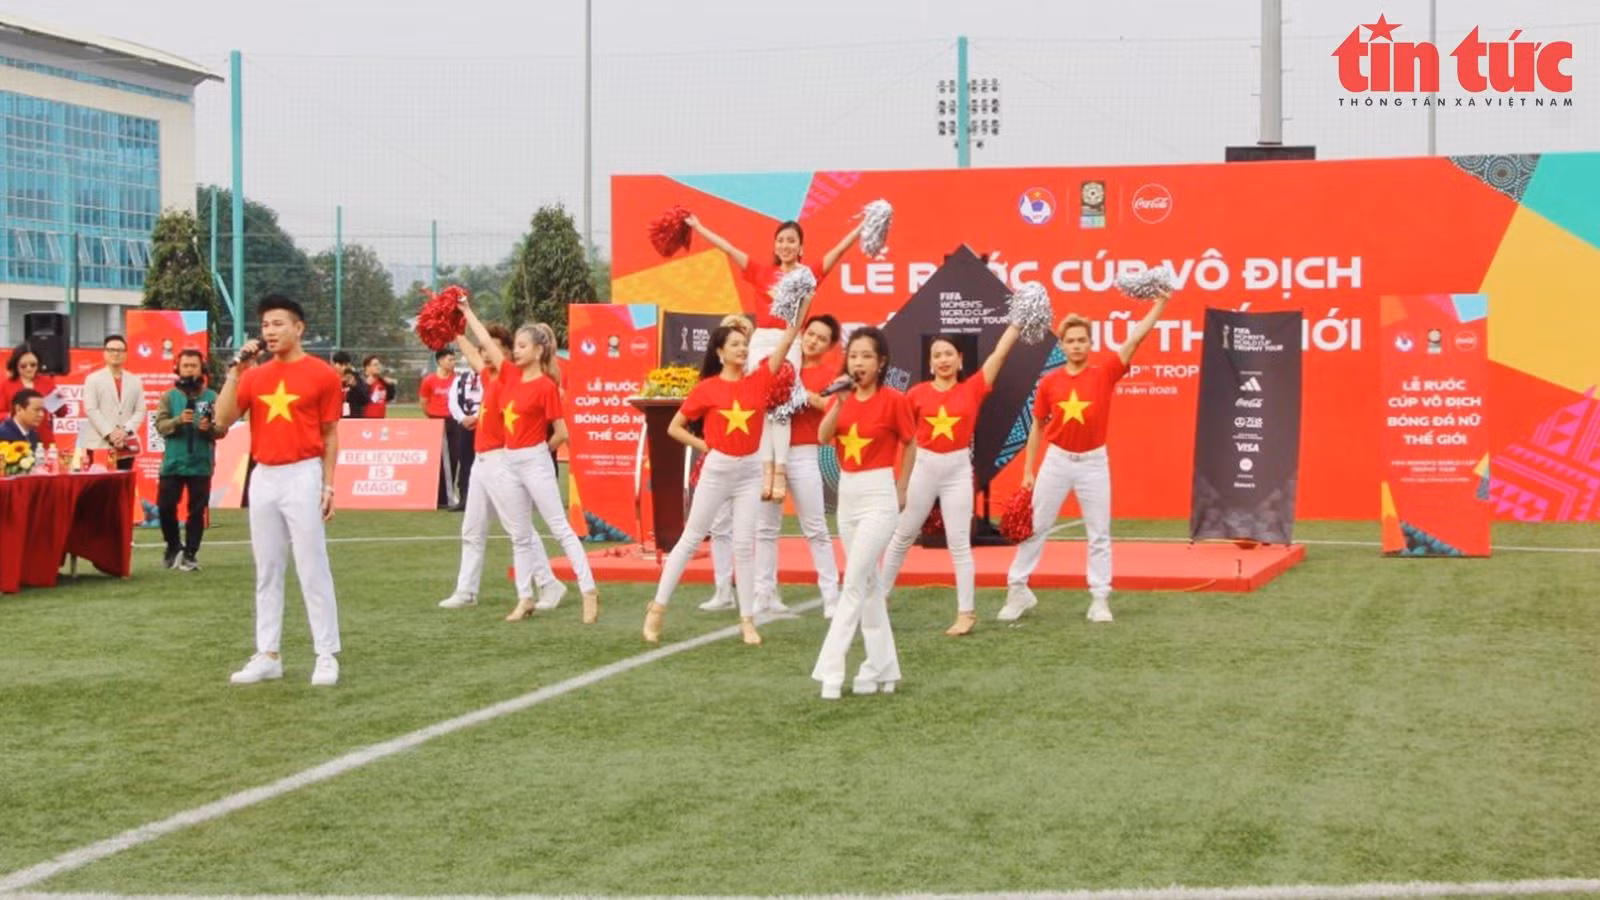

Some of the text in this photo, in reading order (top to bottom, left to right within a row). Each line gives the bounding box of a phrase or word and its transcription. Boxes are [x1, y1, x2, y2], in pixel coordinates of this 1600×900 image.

[1159, 247, 1230, 291] VÔ
[1242, 255, 1362, 299] ĐỊCH
[940, 292, 962, 301] FIFA
[940, 317, 980, 325] TROPHY
[1152, 365, 1200, 378] TROP
[575, 394, 600, 407] CÚP
[1387, 395, 1418, 408] CÚP
[1421, 394, 1442, 407] VÔ
[574, 412, 609, 425] BÓNG
[1387, 413, 1430, 427] BÓNG
[1403, 430, 1433, 445] THẾ
[1235, 442, 1260, 452] VISA
[344, 452, 421, 463] BELIEVING
[374, 468, 388, 478] IS
[356, 482, 404, 493] MAGIC
